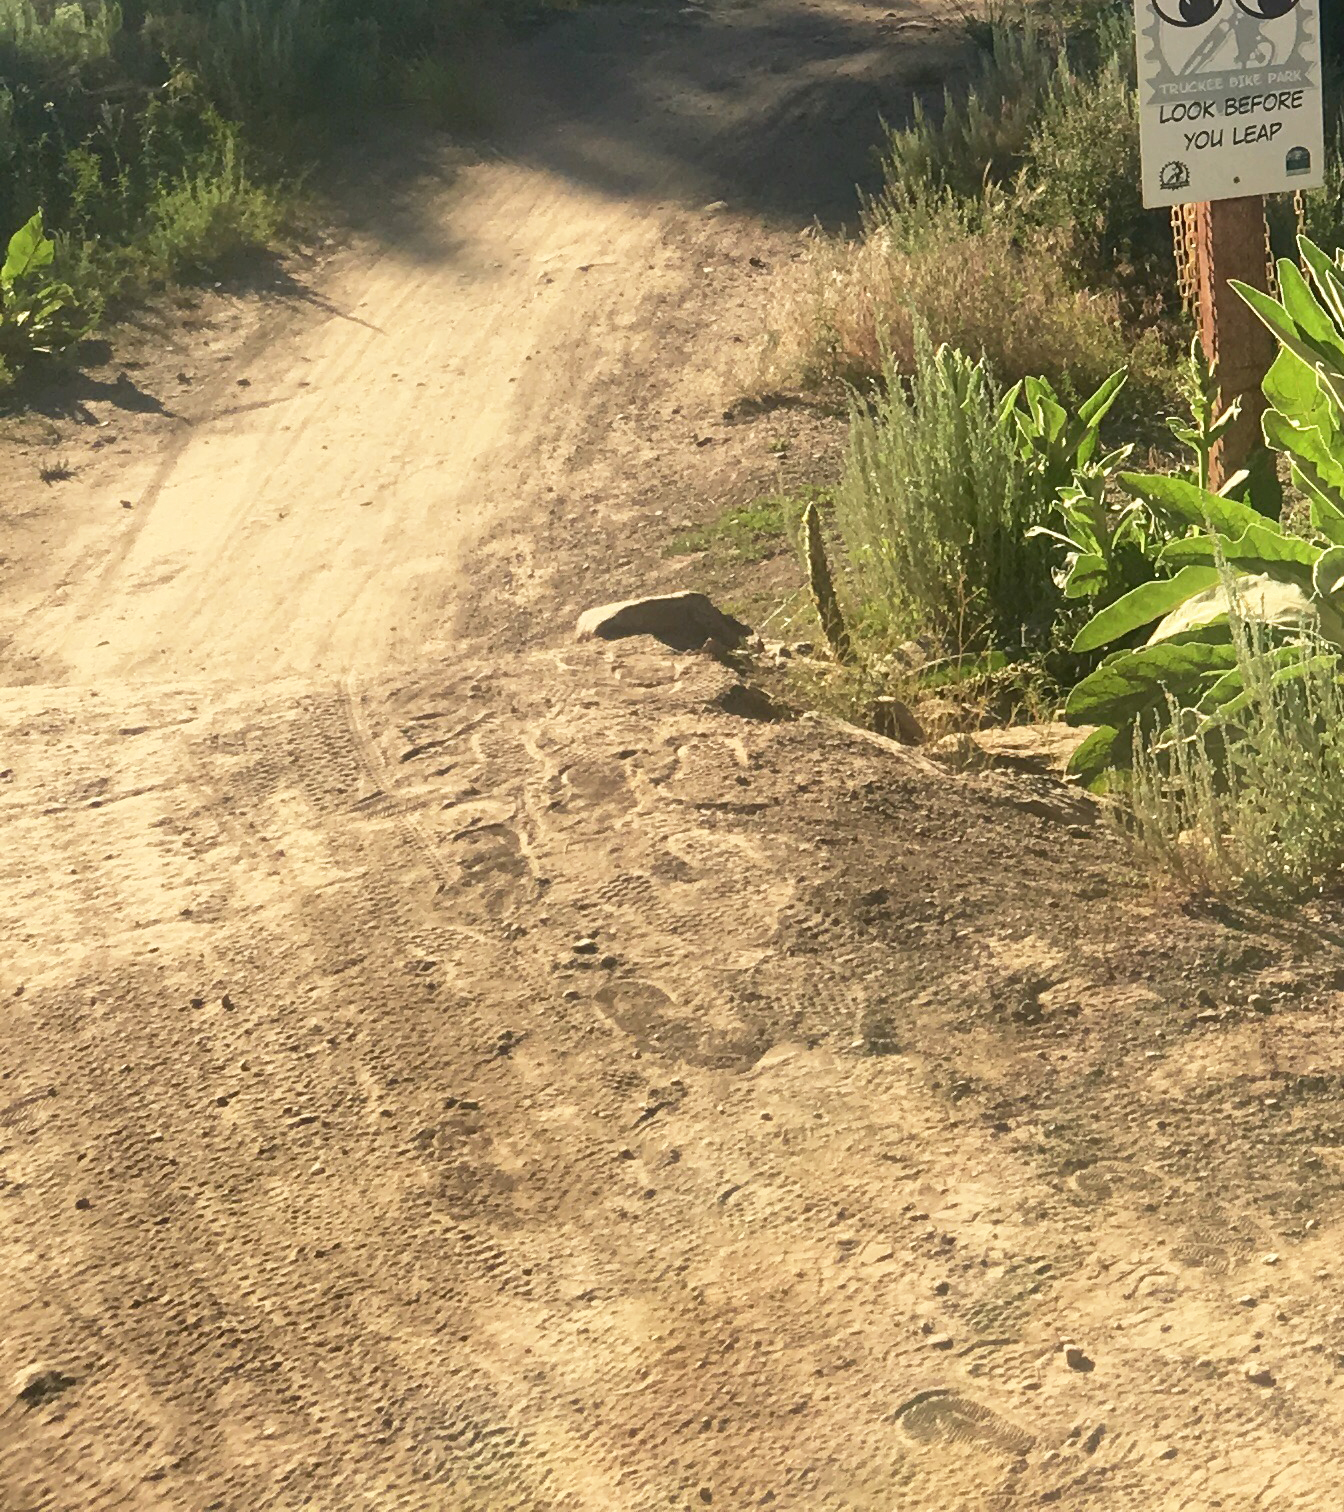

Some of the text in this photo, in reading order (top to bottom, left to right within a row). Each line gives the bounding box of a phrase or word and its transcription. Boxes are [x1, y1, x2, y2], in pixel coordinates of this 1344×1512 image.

[1160, 70, 1302, 95] TRUCKEE BIKE PARK
[1159, 90, 1304, 124] LOOK BEFORE
[1183, 122, 1283, 151] YOU LEAP
